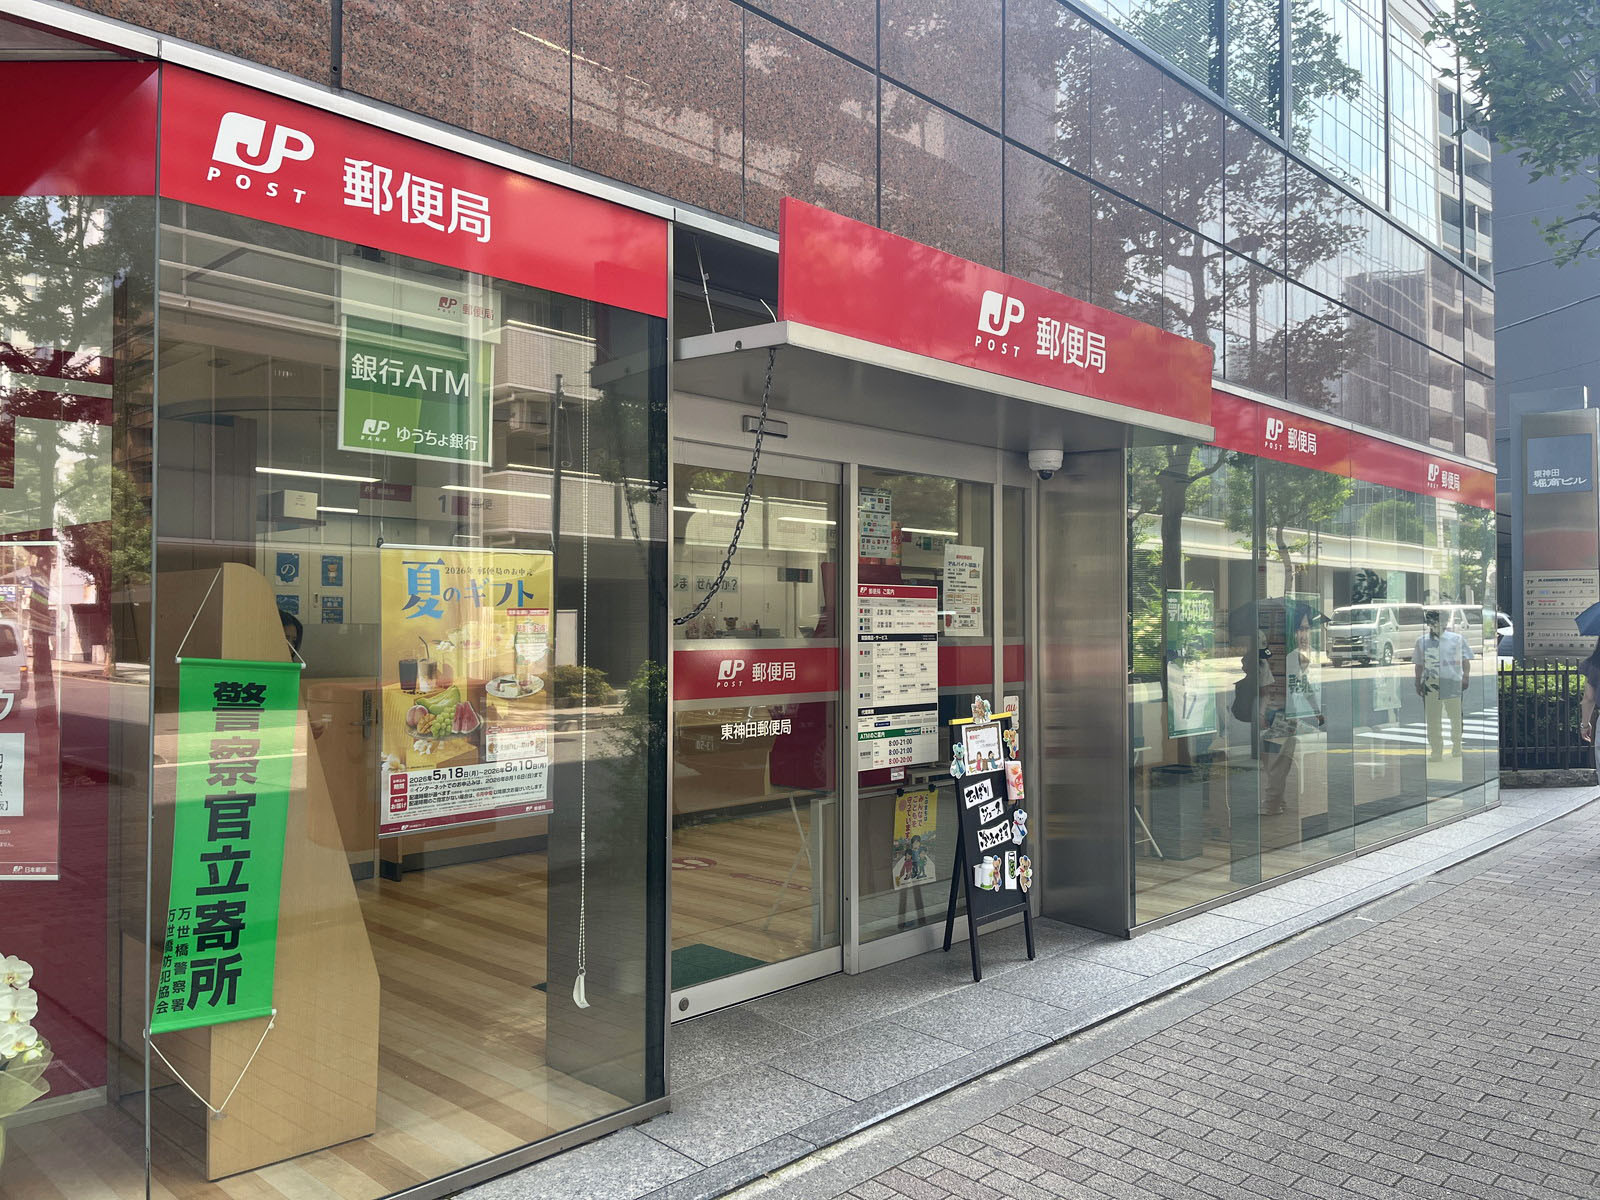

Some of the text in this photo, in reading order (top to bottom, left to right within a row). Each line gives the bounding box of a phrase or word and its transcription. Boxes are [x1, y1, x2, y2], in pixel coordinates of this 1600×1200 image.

[211, 111, 315, 174] JP
[207, 166, 306, 204] POST
[343, 157, 491, 243] 郵便局
[438, 296, 457, 309] JP
[462, 303, 494, 320] 郵便局
[977, 290, 1025, 337] JP
[975, 335, 1020, 358] POST
[1036, 316, 1106, 374] 郵便局
[351, 353, 470, 398] 銀行ATM
[361, 418, 390, 436] JP
[396, 426, 479, 451] ゆうちょ銀行
[1265, 417, 1284, 441] JP
[1264, 441, 1283, 452] POST
[1287, 427, 1317, 456] 郵便局
[1427, 463, 1440, 482] JP
[1441, 470, 1461, 491] 郵便局
[1427, 481, 1439, 489] POST
[401, 558, 535, 620] 夏のギフト
[718, 659, 745, 680] JP
[752, 661, 796, 683] 郵便局
[716, 680, 743, 688] POST
[720, 719, 792, 741] 東神田郵便局
[187, 681, 267, 1011] 警察官立寄所
[155, 908, 177, 1015] 万世橋防犯協会
[171, 907, 192, 1013] 万世橋警察署
